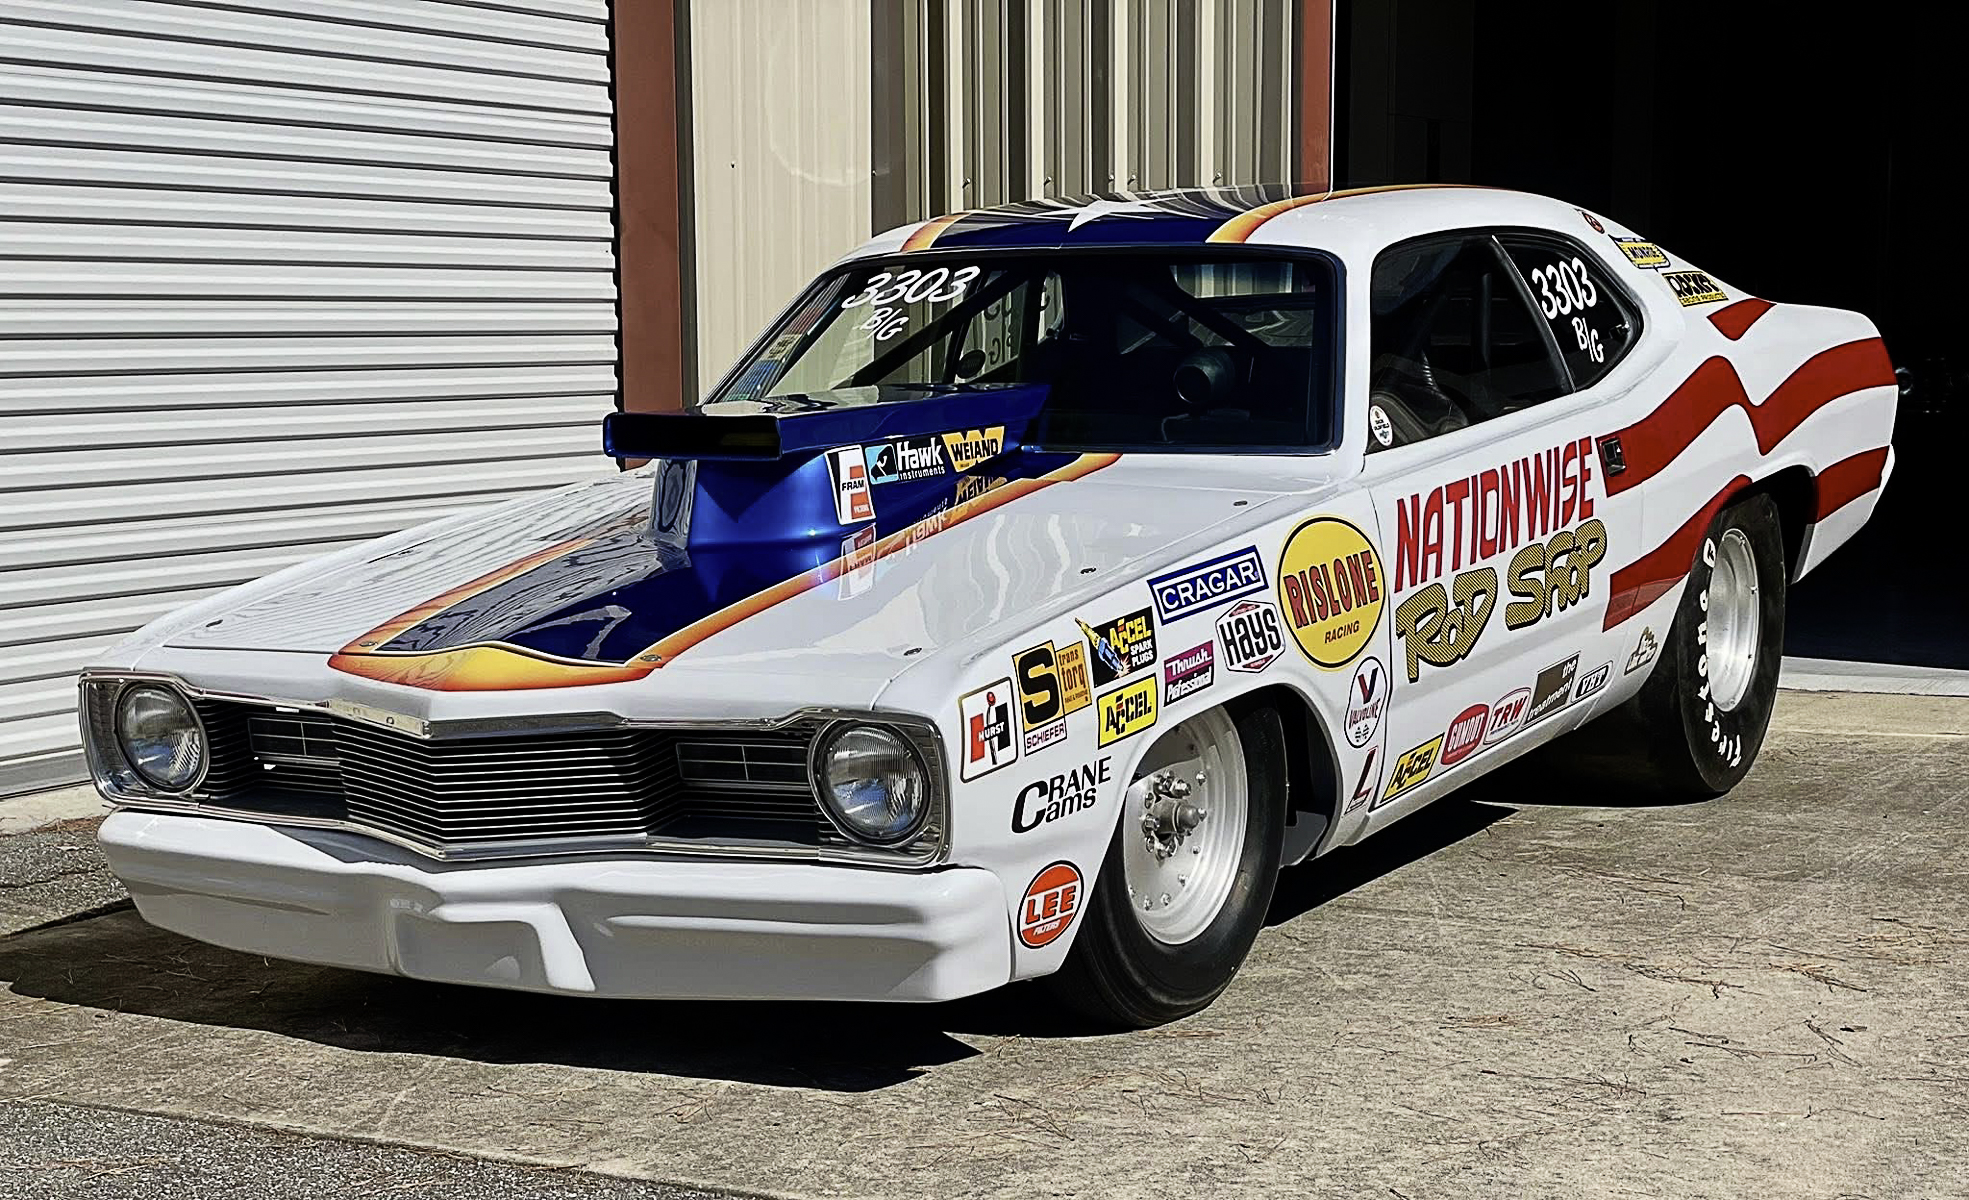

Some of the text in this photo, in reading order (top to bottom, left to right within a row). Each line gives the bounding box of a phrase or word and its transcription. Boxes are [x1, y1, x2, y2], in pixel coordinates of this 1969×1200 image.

[841, 266, 980, 308] 3303
[1532, 257, 1597, 319] 3303
[853, 308, 909, 341] B/G
[1572, 317, 1604, 363] B/G
[896, 438, 944, 471] Hawk
[950, 438, 999, 462] WEIAND
[841, 479, 865, 491] FRAM
[1394, 436, 1593, 593] NATIONWISE
[1162, 561, 1257, 610] CRAGAR
[1283, 550, 1379, 629] RISLONE
[1109, 616, 1152, 654] ACCEL
[1130, 639, 1153, 655] SPARK
[1219, 608, 1281, 667] Hays
[1325, 620, 1360, 644] RACING
[1059, 649, 1079, 666] trans
[1132, 651, 1154, 667] PLUGS
[1166, 648, 1213, 677] Thrush
[1562, 659, 1577, 679] the
[1061, 663, 1086, 692] torq
[1167, 666, 1212, 702] Professional
[1580, 667, 1607, 695] VHT
[1105, 691, 1152, 735] ACCEL
[1490, 696, 1528, 731] TRW
[978, 722, 1005, 742] HURST
[1026, 722, 1065, 749] SCHIEFER
[1448, 712, 1486, 752] GUMOUT
[1391, 747, 1434, 789] ACCEL
[1012, 756, 1111, 833] CRANE
[1025, 885, 1076, 925] LEE
